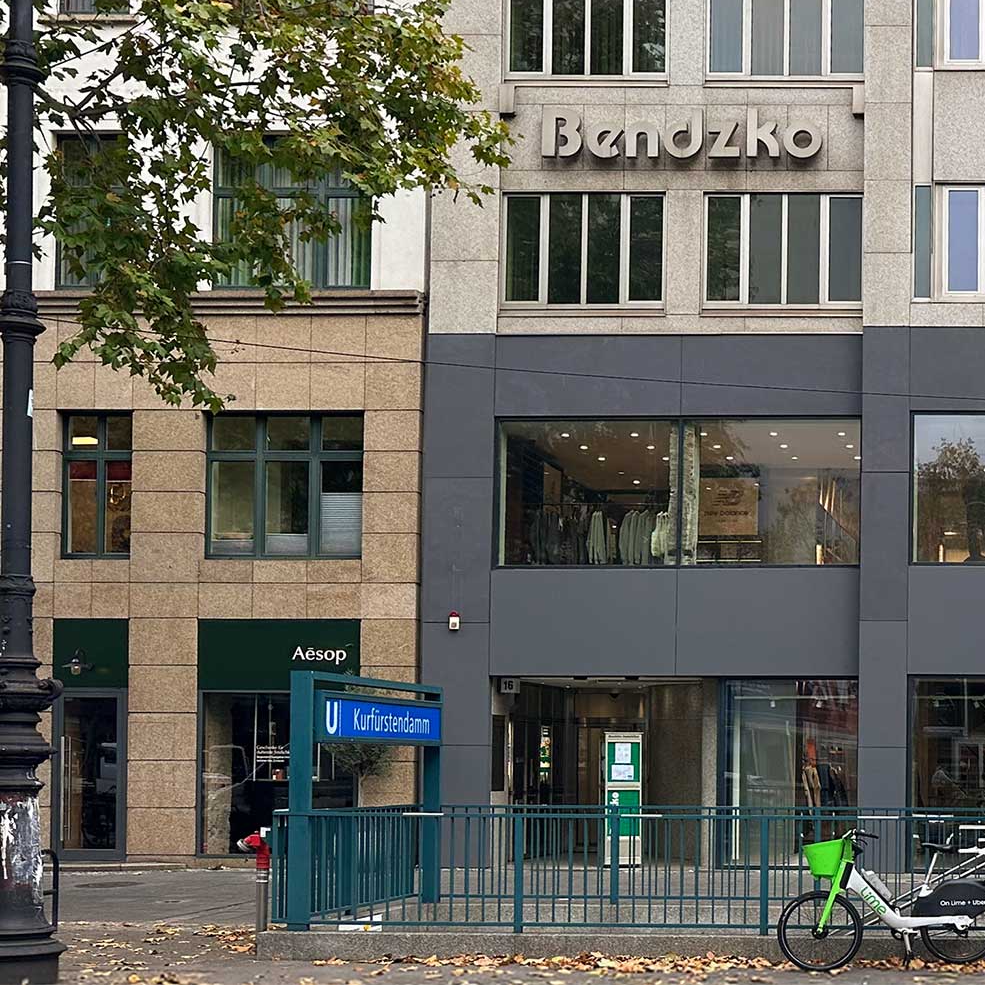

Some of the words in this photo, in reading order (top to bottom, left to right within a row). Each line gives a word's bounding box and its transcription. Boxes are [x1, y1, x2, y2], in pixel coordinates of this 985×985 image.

[541, 105, 824, 160] Bendzko
[292, 646, 347, 665] Aēsop
[503, 680, 514, 690] 16
[326, 701, 338, 734] U
[353, 707, 430, 735] Kurfürstendamm
[860, 886, 888, 915] Lime
